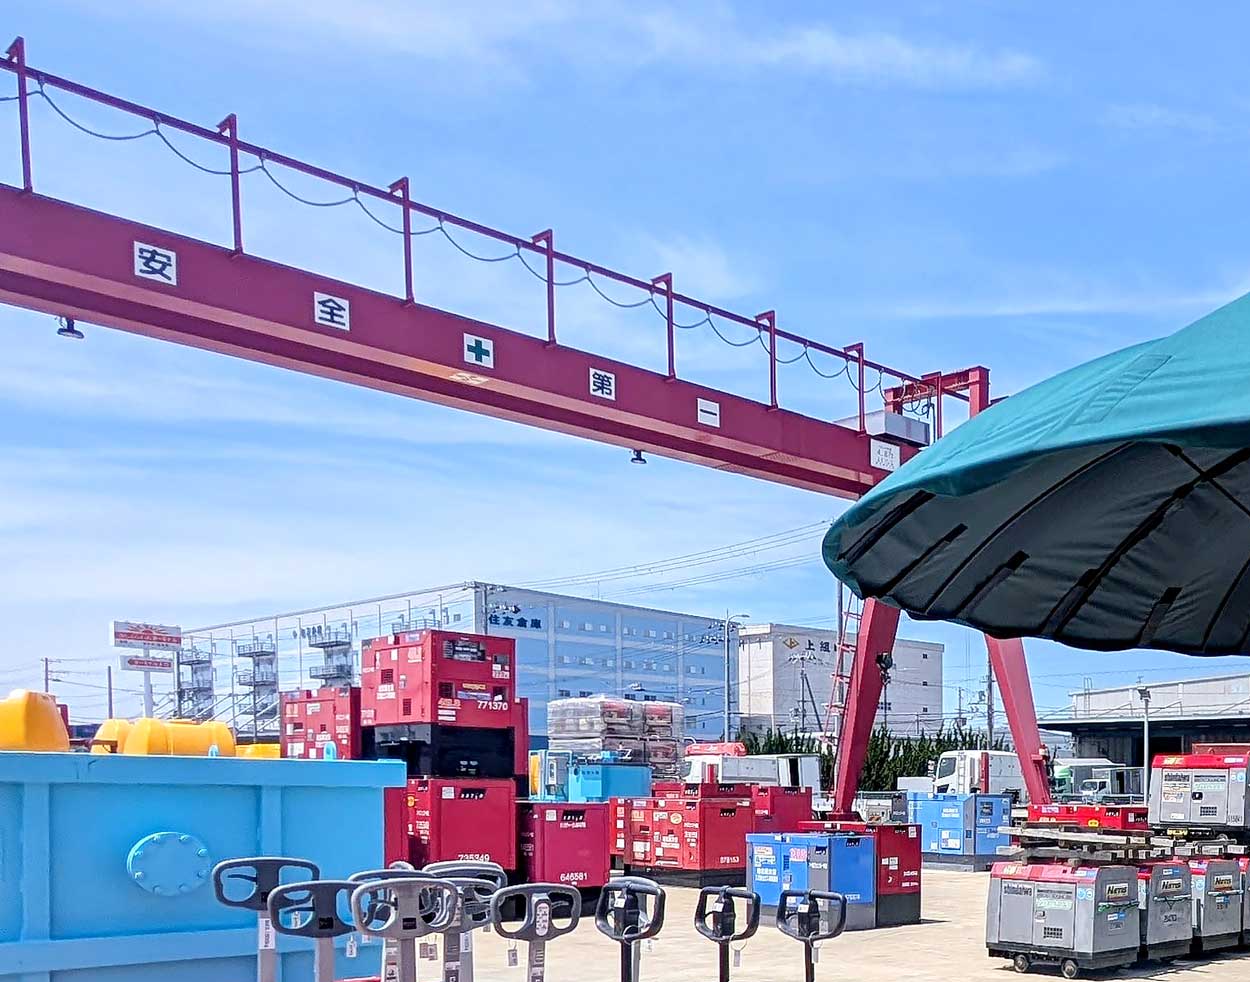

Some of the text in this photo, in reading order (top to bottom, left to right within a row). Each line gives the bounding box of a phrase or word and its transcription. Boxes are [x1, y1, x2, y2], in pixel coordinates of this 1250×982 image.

[139, 248, 172, 281] 安
[318, 299, 346, 327] 全
[592, 371, 613, 396] 第
[488, 614, 542, 629] 住友倉庫
[804, 639, 837, 653] 上組
